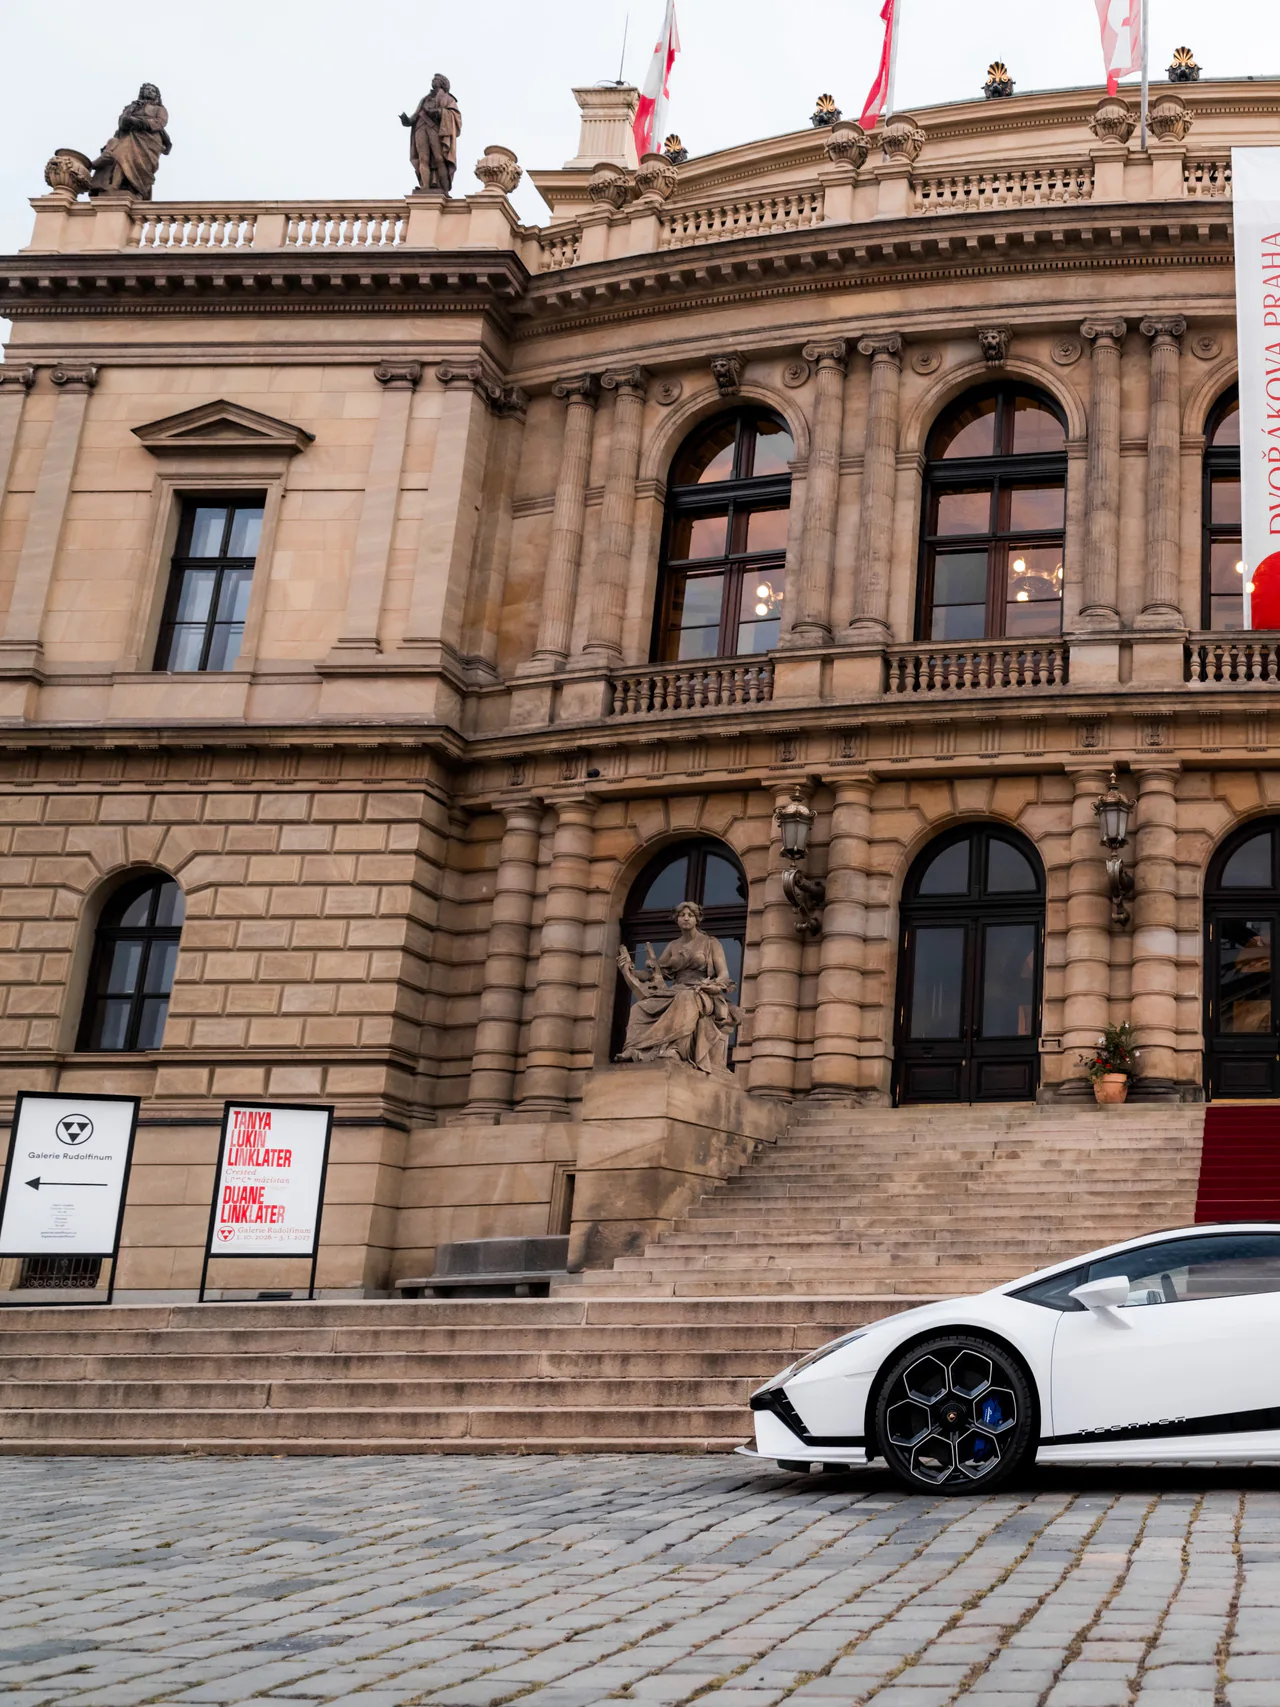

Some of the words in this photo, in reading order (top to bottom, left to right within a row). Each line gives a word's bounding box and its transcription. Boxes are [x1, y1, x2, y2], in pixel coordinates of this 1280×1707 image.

[234, 1111, 271, 1130] TANYA
[230, 1130, 266, 1148] LUKIN
[228, 1148, 292, 1167] LINKLATER
[223, 1186, 265, 1204] DUANE
[220, 1205, 285, 1223] LINKLATER
